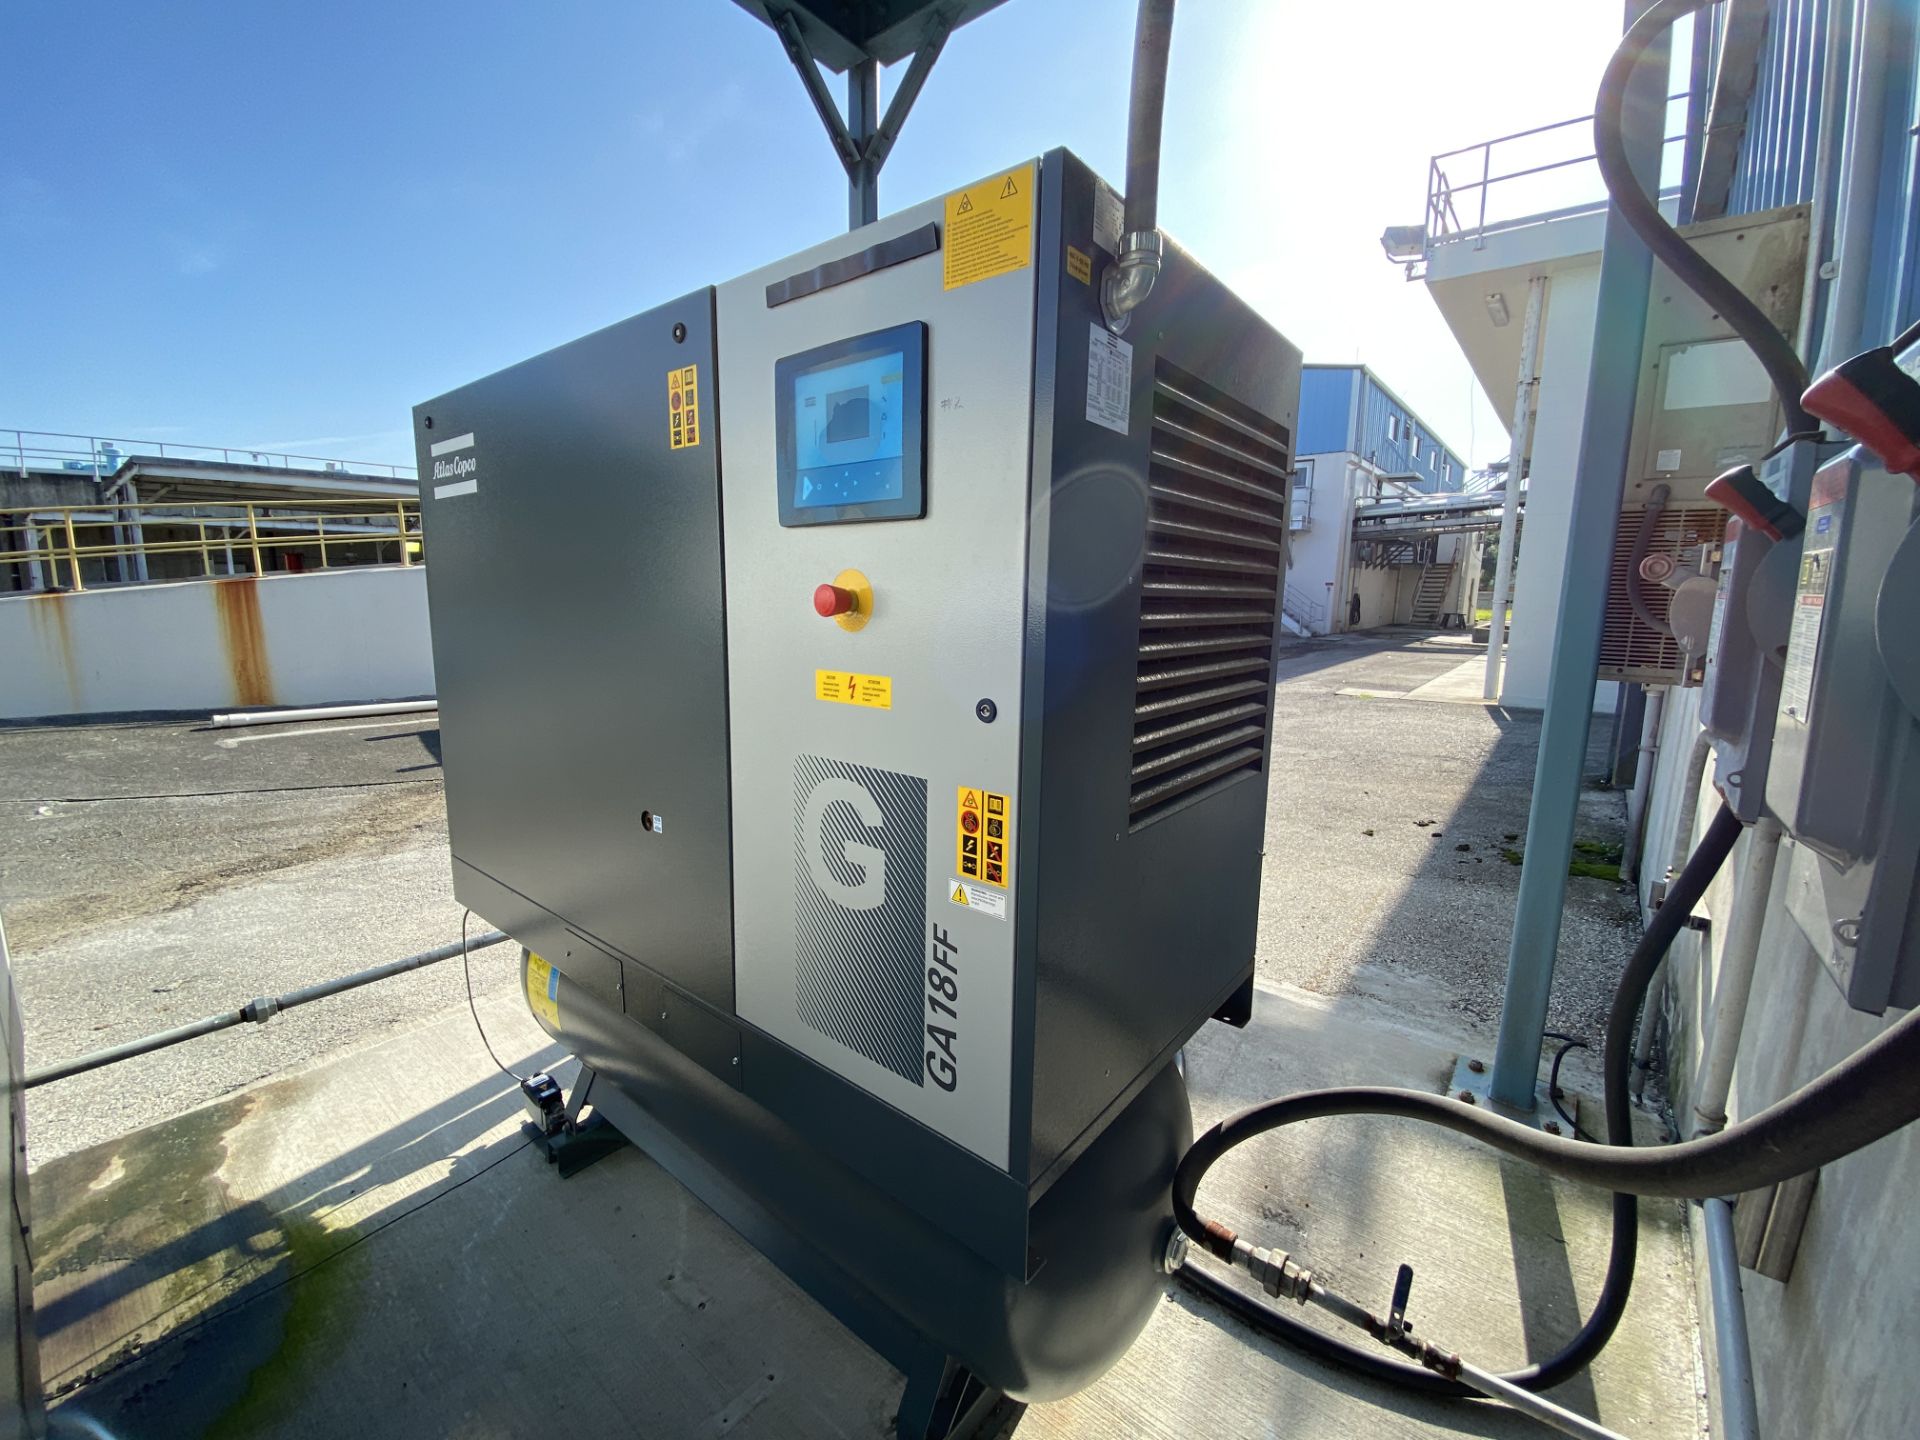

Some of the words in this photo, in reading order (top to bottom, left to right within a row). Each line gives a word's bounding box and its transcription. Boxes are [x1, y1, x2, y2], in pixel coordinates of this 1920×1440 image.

[433, 460, 453, 479] Atlas
[454, 456, 476, 477] Copco
[802, 776, 886, 910] G
[927, 922, 959, 1020] 18FF
[926, 1023, 958, 1093] GA
